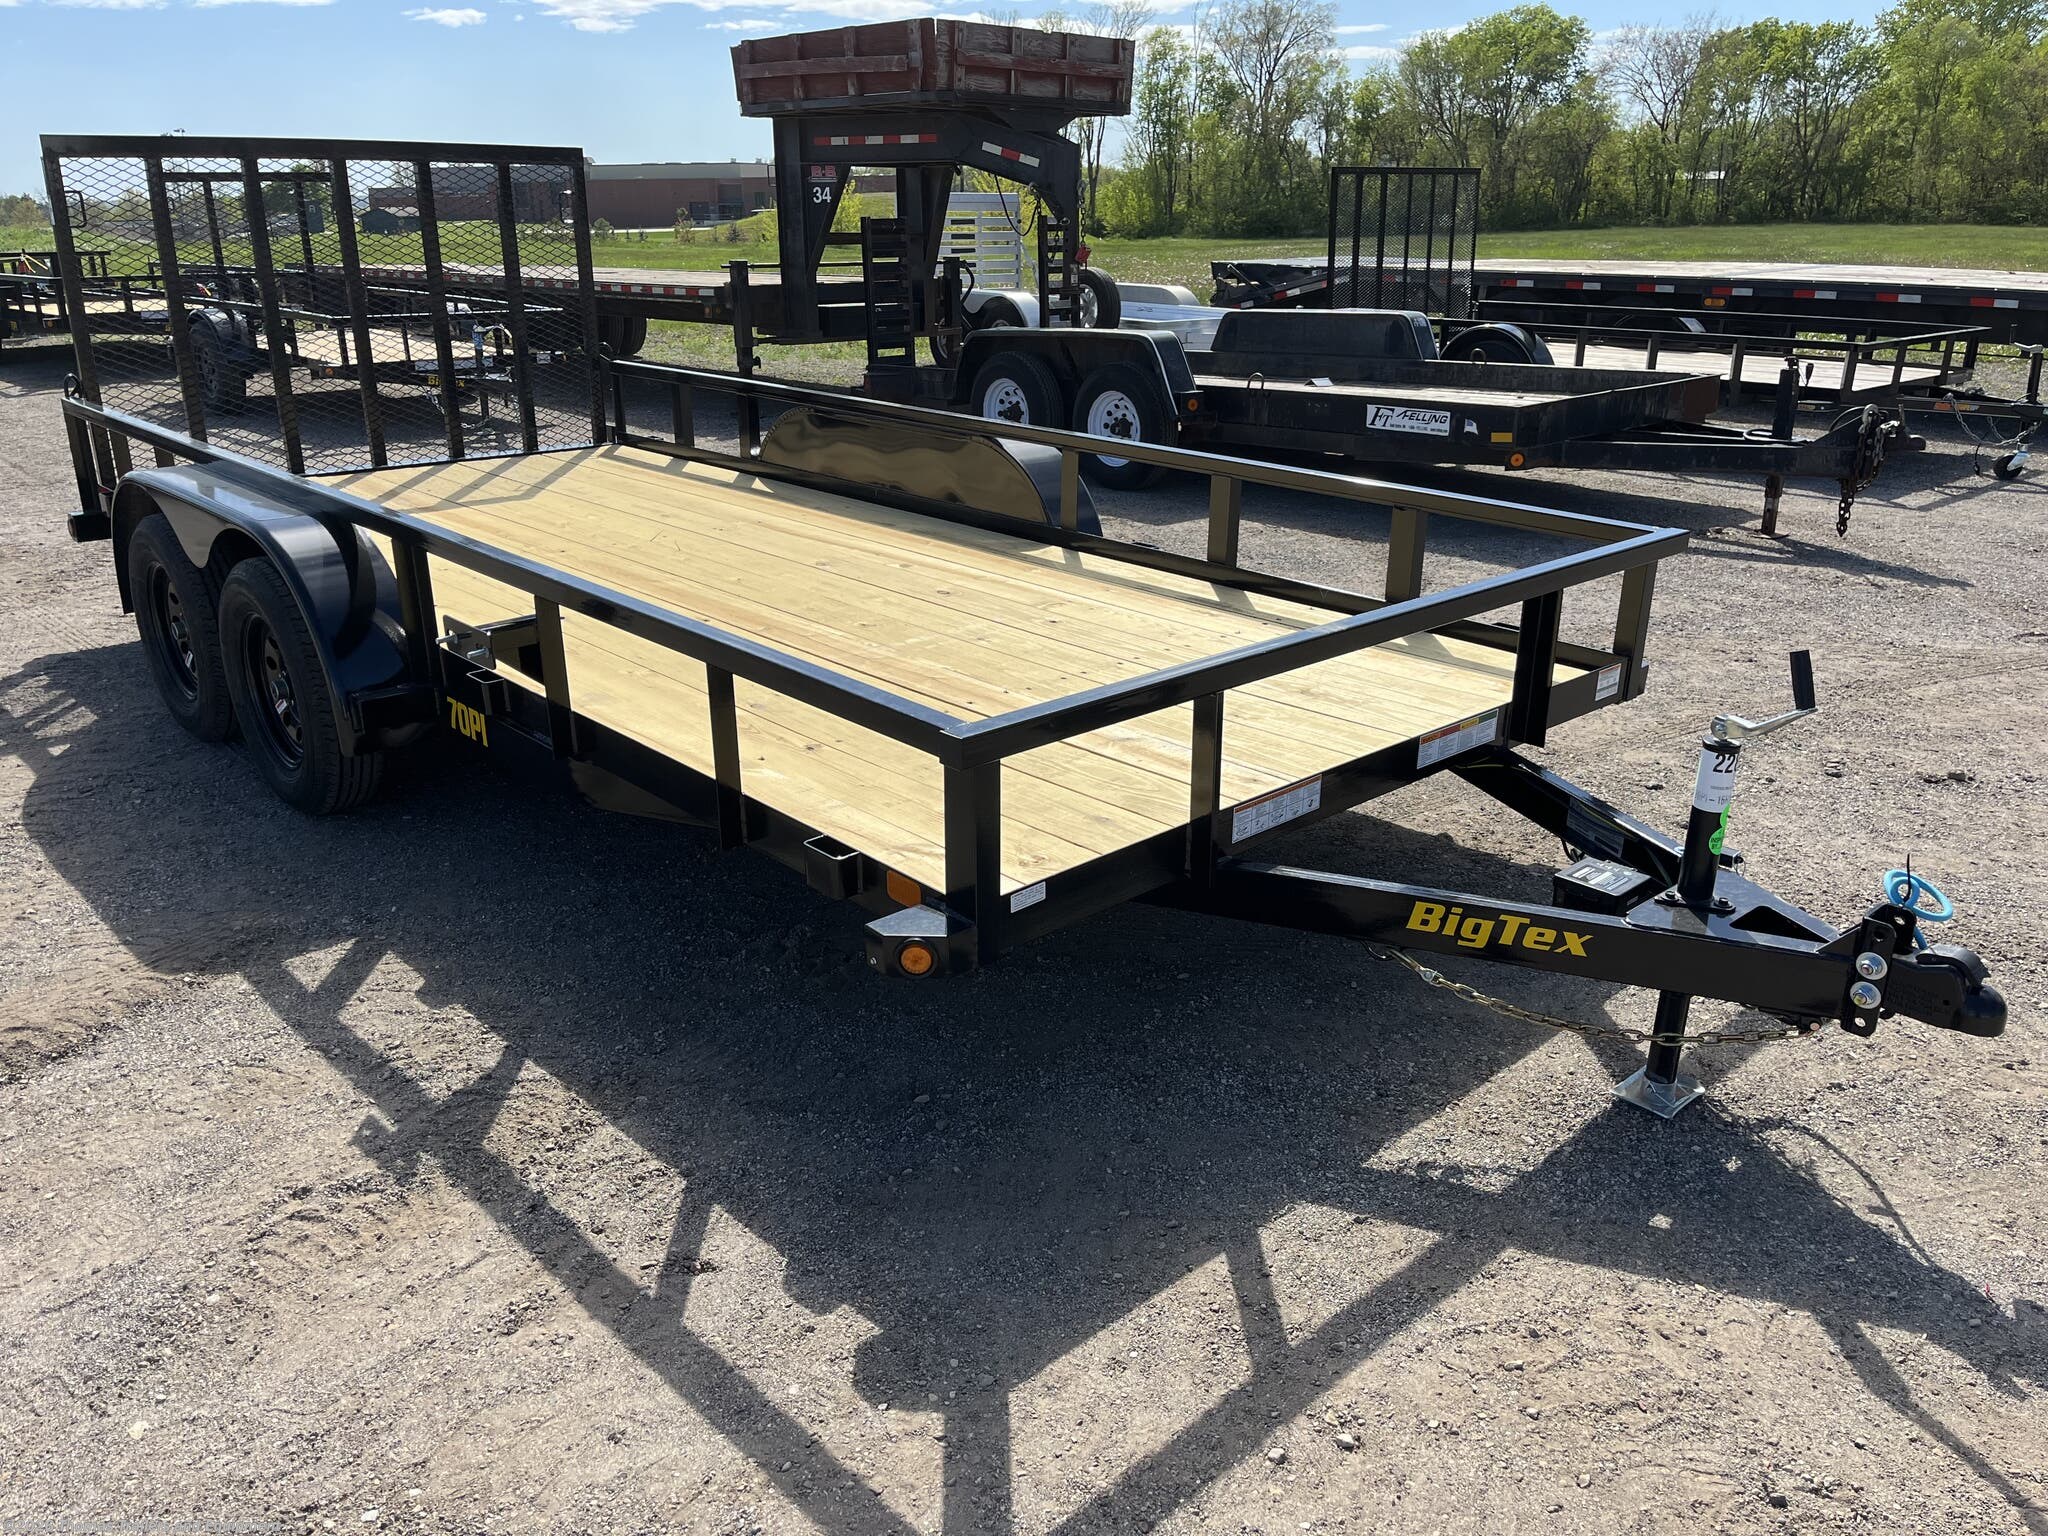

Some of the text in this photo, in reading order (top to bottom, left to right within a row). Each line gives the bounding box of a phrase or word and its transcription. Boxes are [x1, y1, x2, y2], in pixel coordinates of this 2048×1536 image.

[813, 186, 832, 203] 34
[1396, 409, 1449, 424] FELLING
[446, 696, 489, 748] 70PI
[1405, 901, 1594, 957] BigTex
